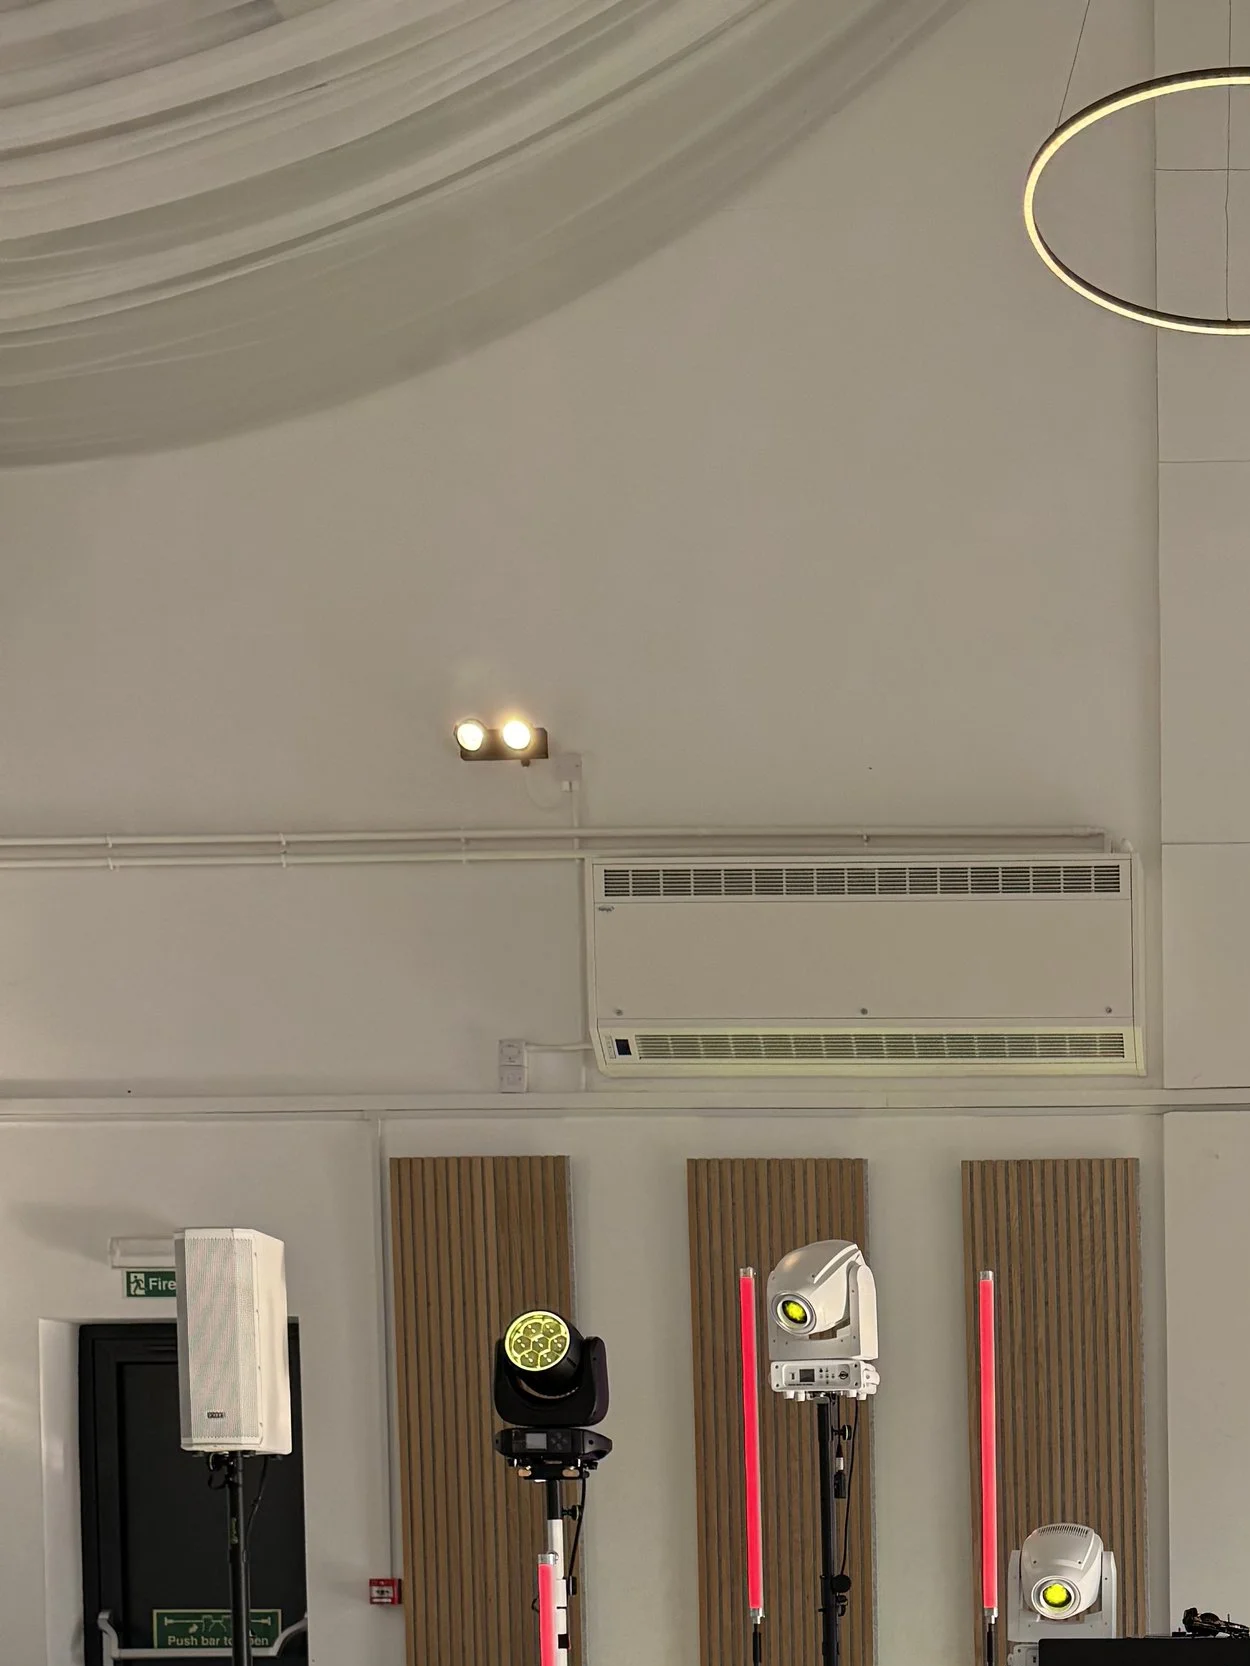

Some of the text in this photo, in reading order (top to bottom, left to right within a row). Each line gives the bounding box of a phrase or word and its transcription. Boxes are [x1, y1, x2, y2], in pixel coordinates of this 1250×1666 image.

[148, 1277, 177, 1291] Fire
[167, 1635, 198, 1646] Push
[201, 1635, 220, 1646] bar
